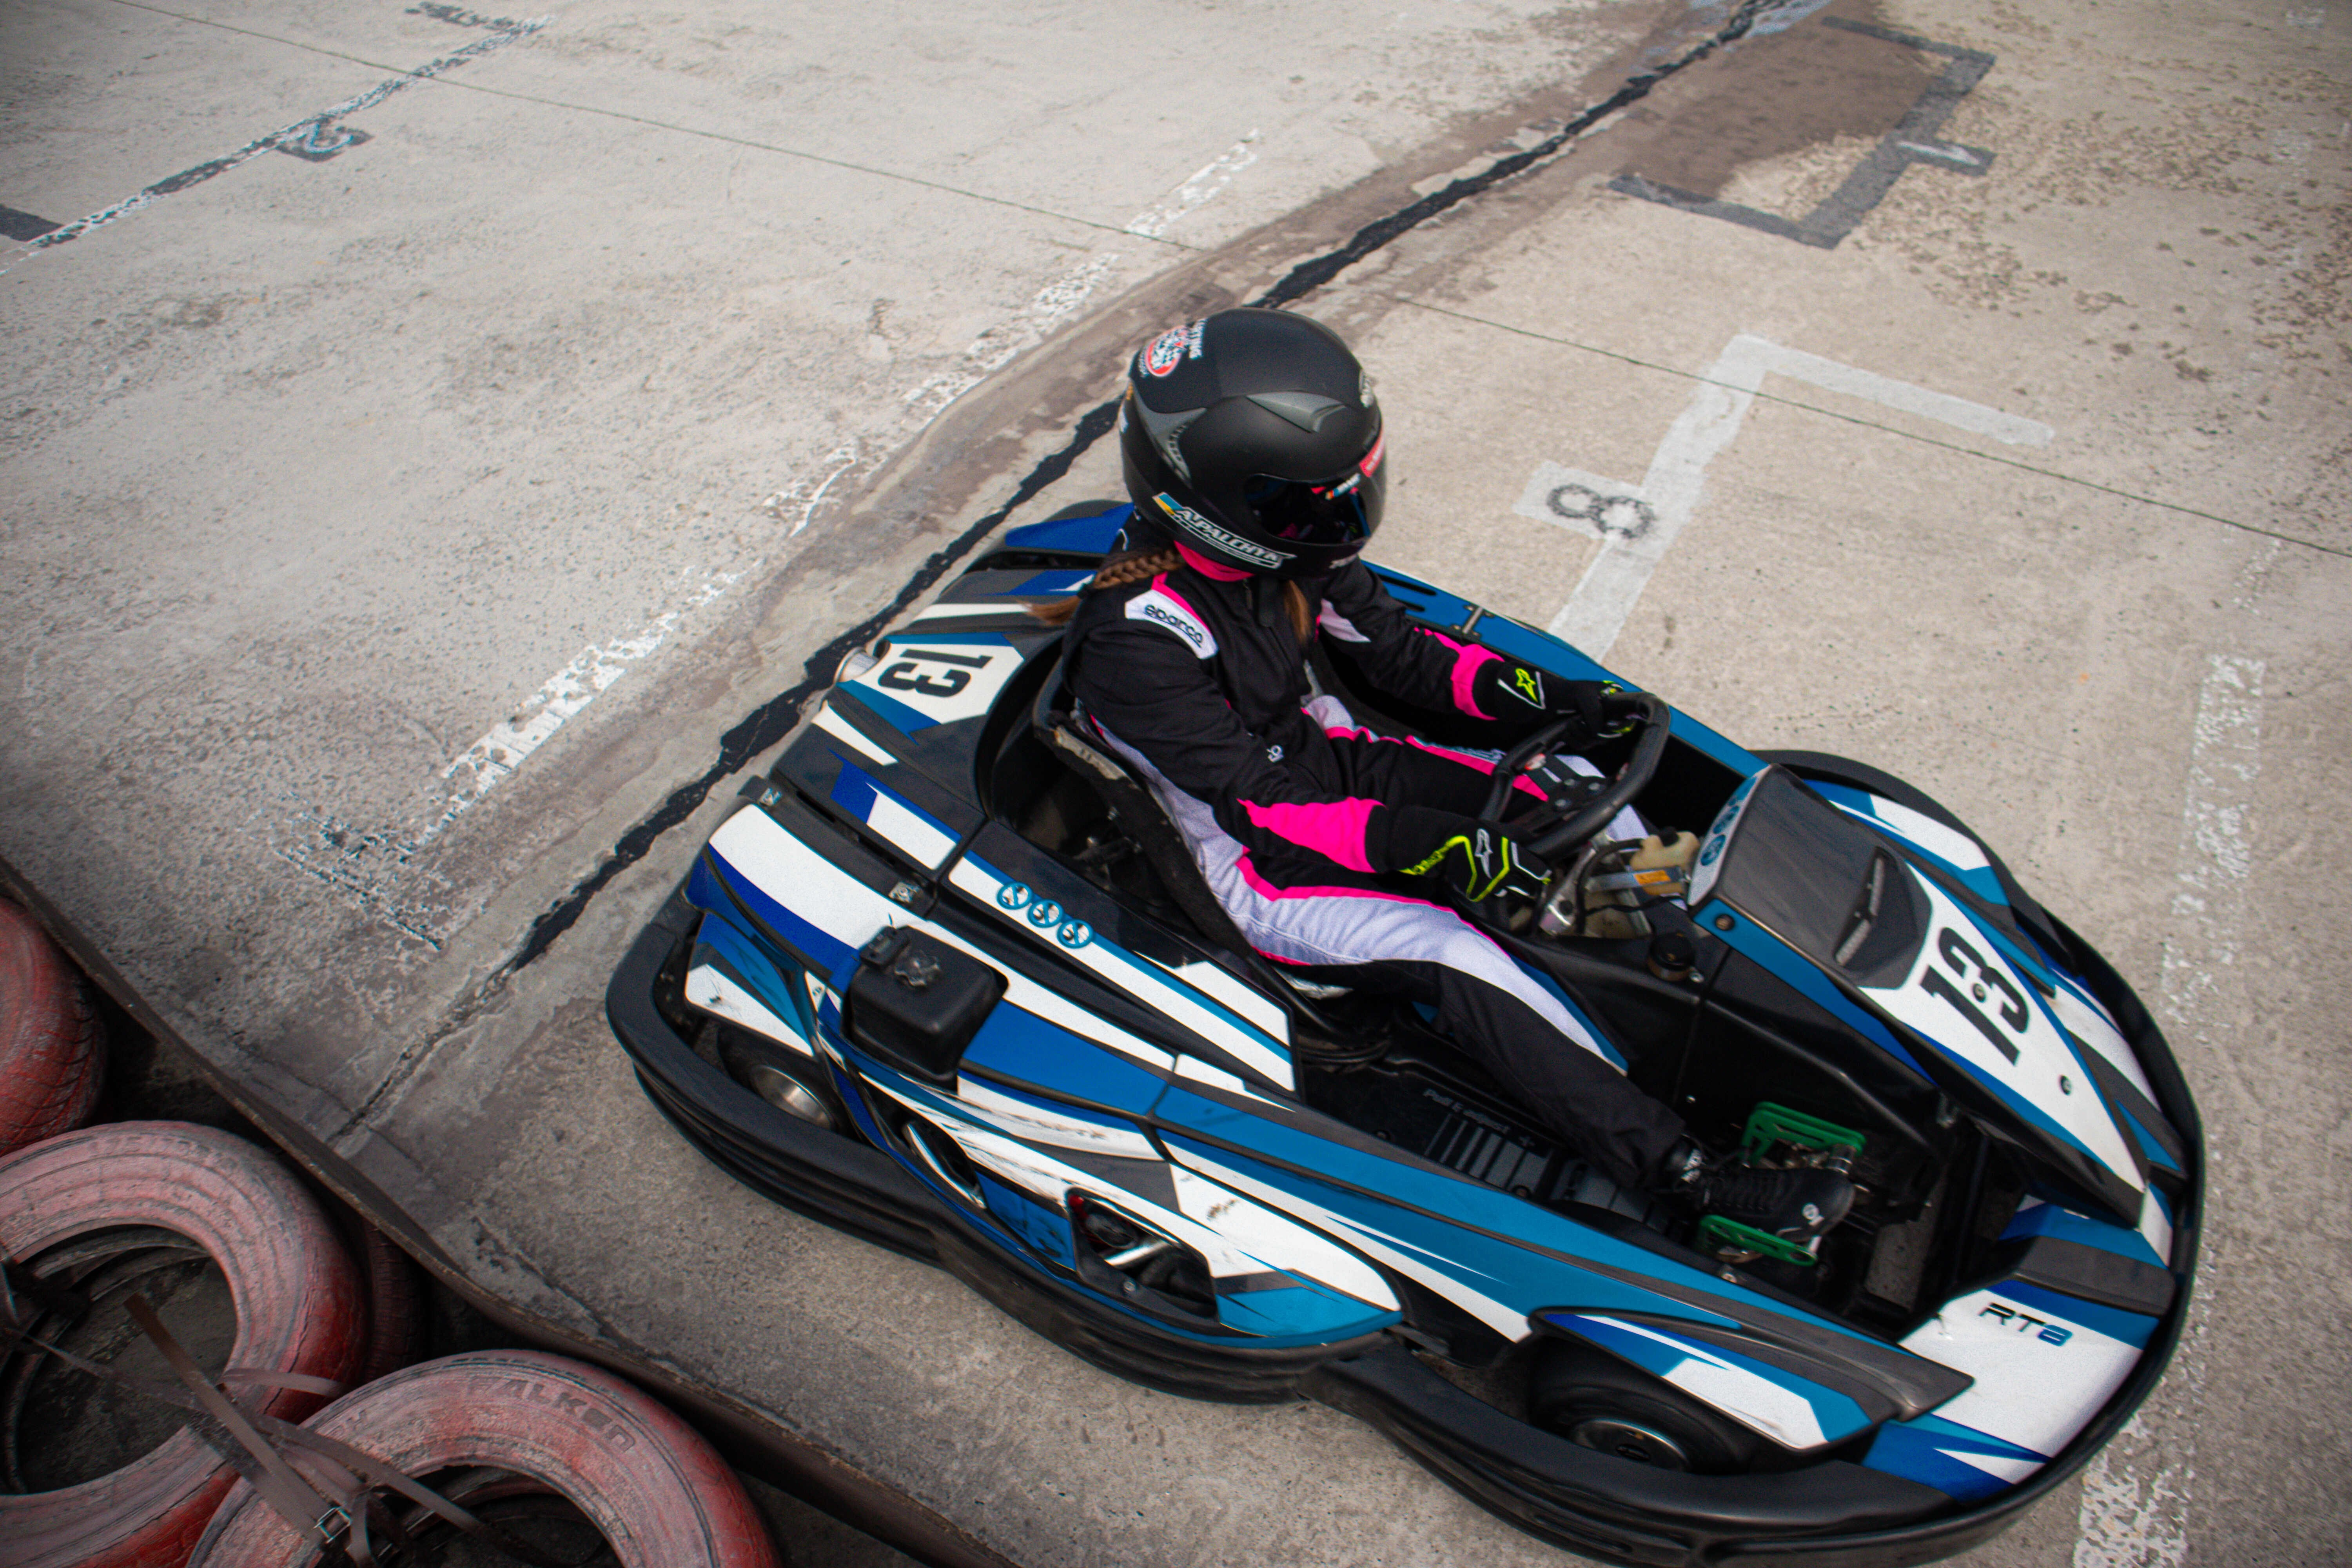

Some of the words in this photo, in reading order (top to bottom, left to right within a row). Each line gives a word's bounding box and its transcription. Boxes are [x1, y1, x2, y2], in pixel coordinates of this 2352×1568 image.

[1145, 604, 1203, 643] sparco
[878, 649, 994, 698] 13
[1919, 927, 2029, 1066] 13
[1978, 1302, 2073, 1346] RT8
